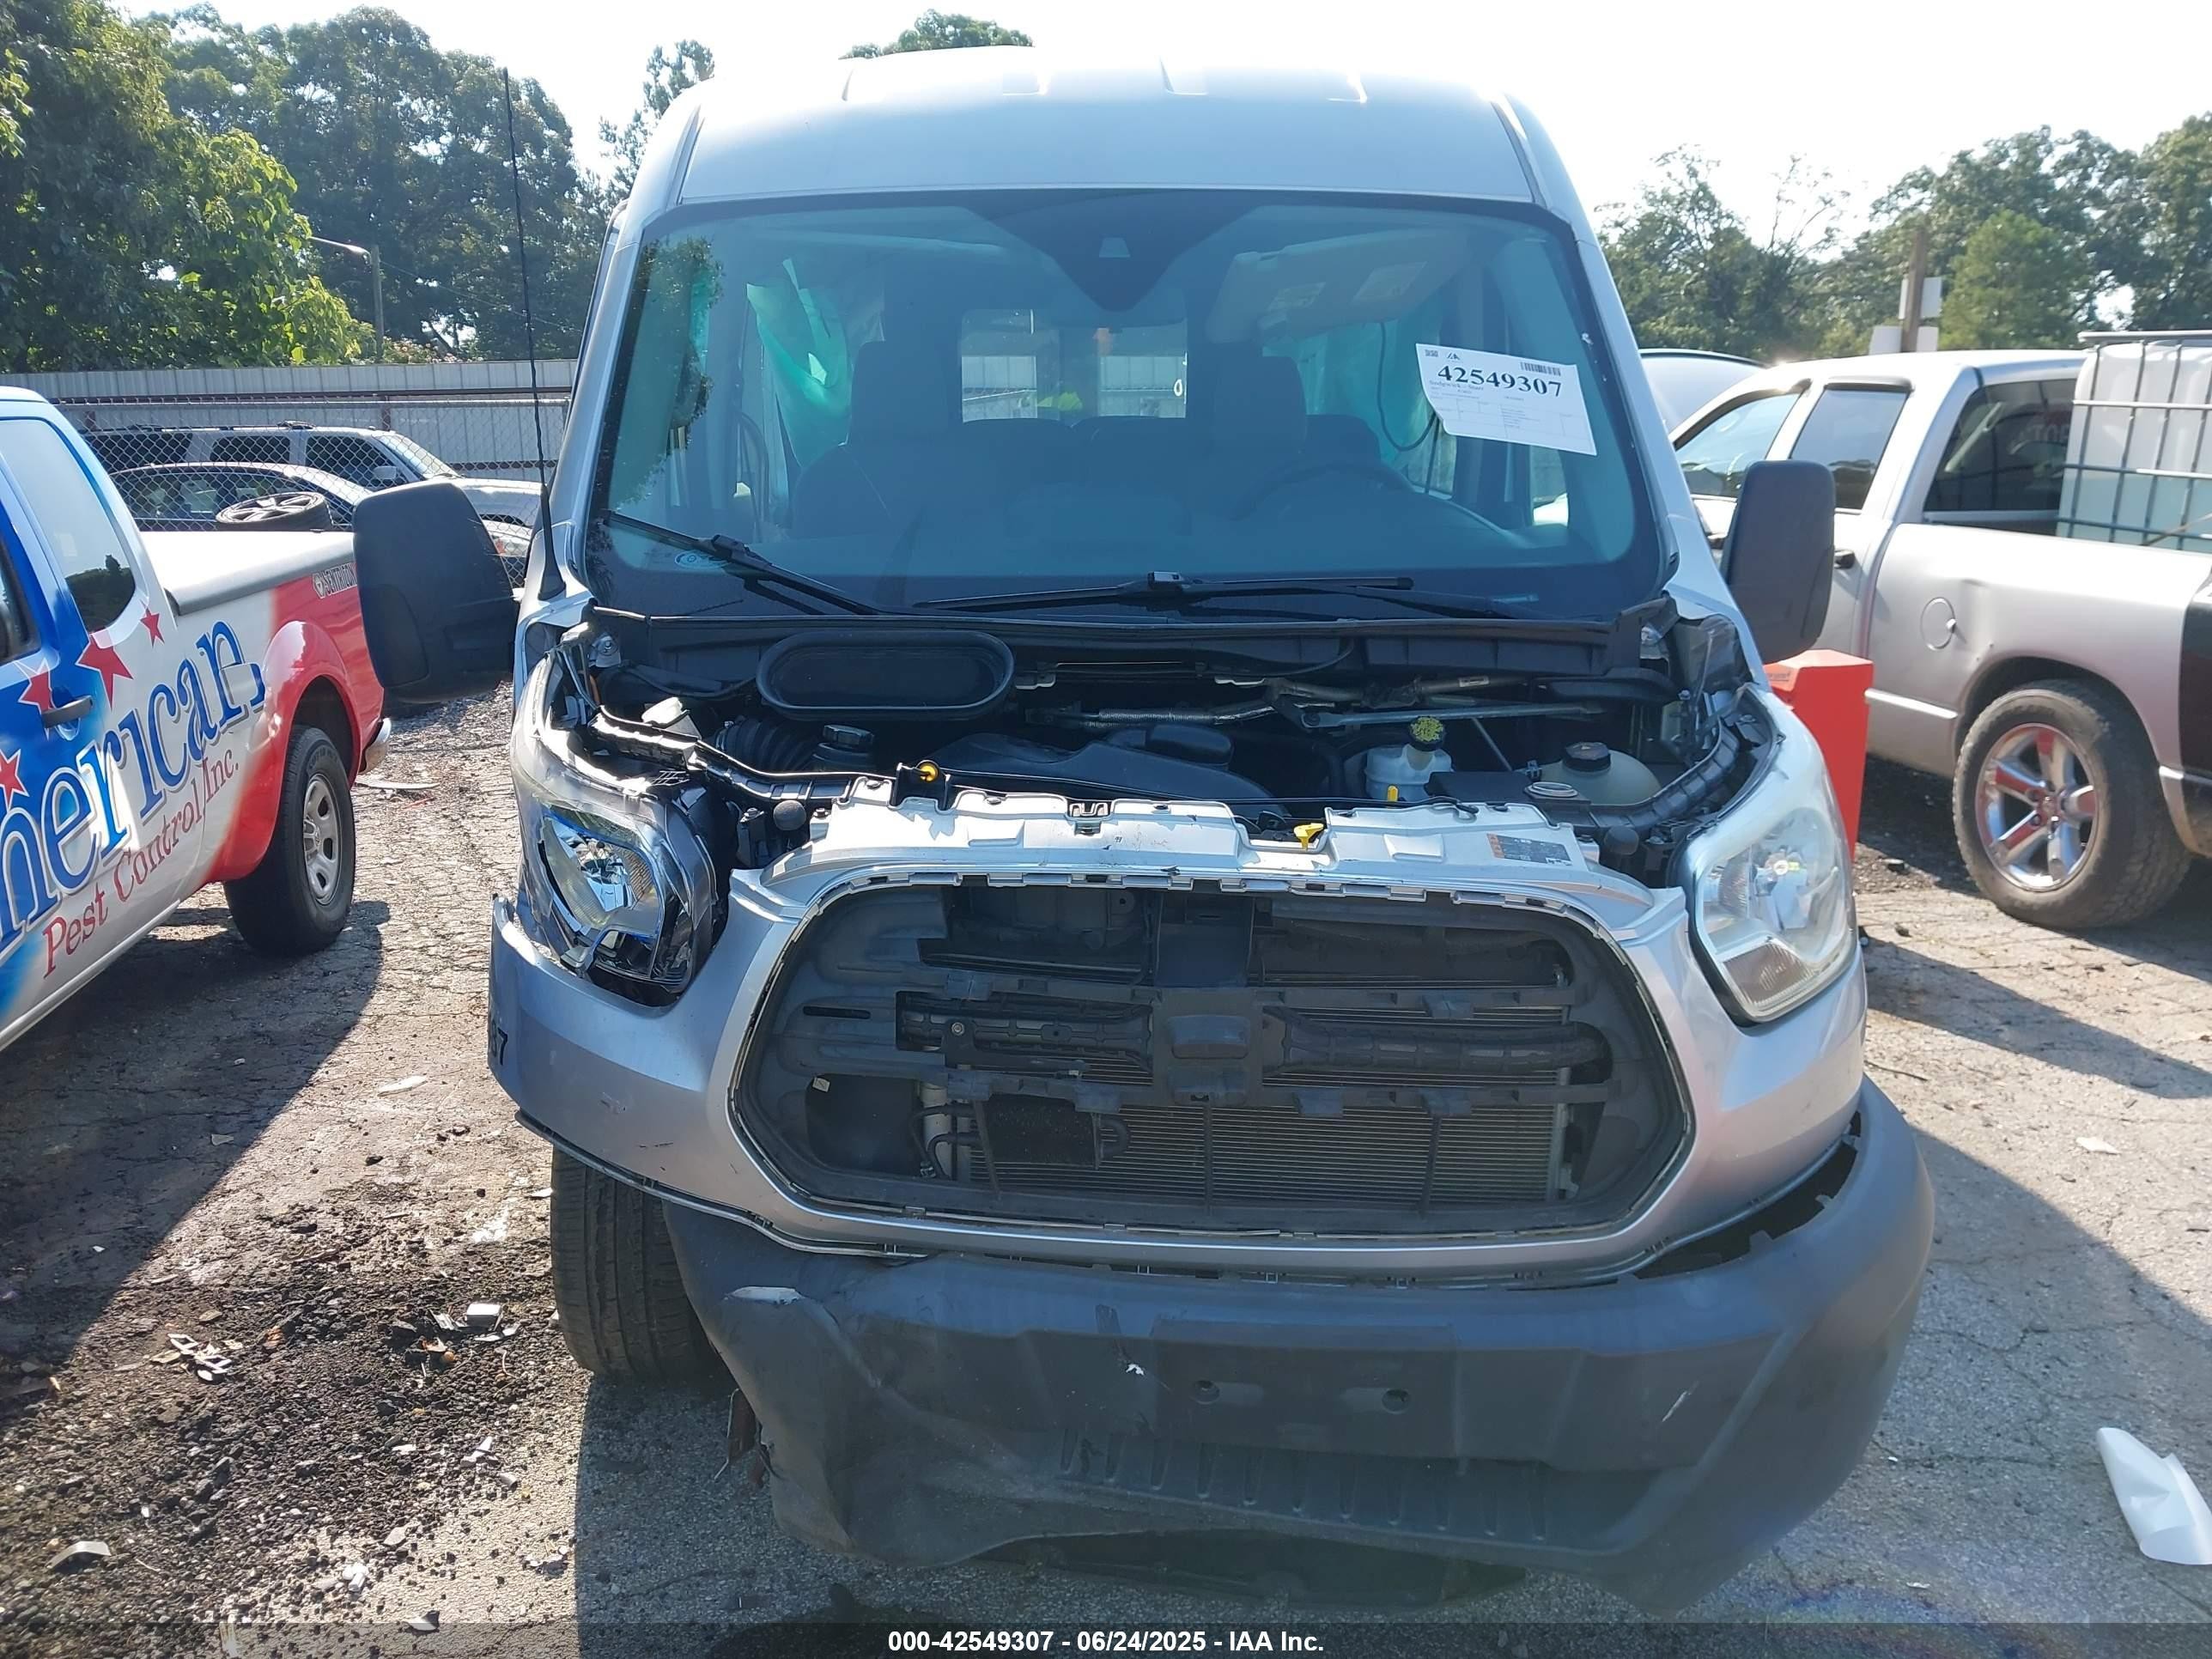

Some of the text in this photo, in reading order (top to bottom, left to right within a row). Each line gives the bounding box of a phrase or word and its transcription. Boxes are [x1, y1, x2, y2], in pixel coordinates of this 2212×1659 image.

[1437, 365, 1562, 398] 42549307
[43, 882, 109, 979] Pest
[202, 749, 239, 804] Inc.
